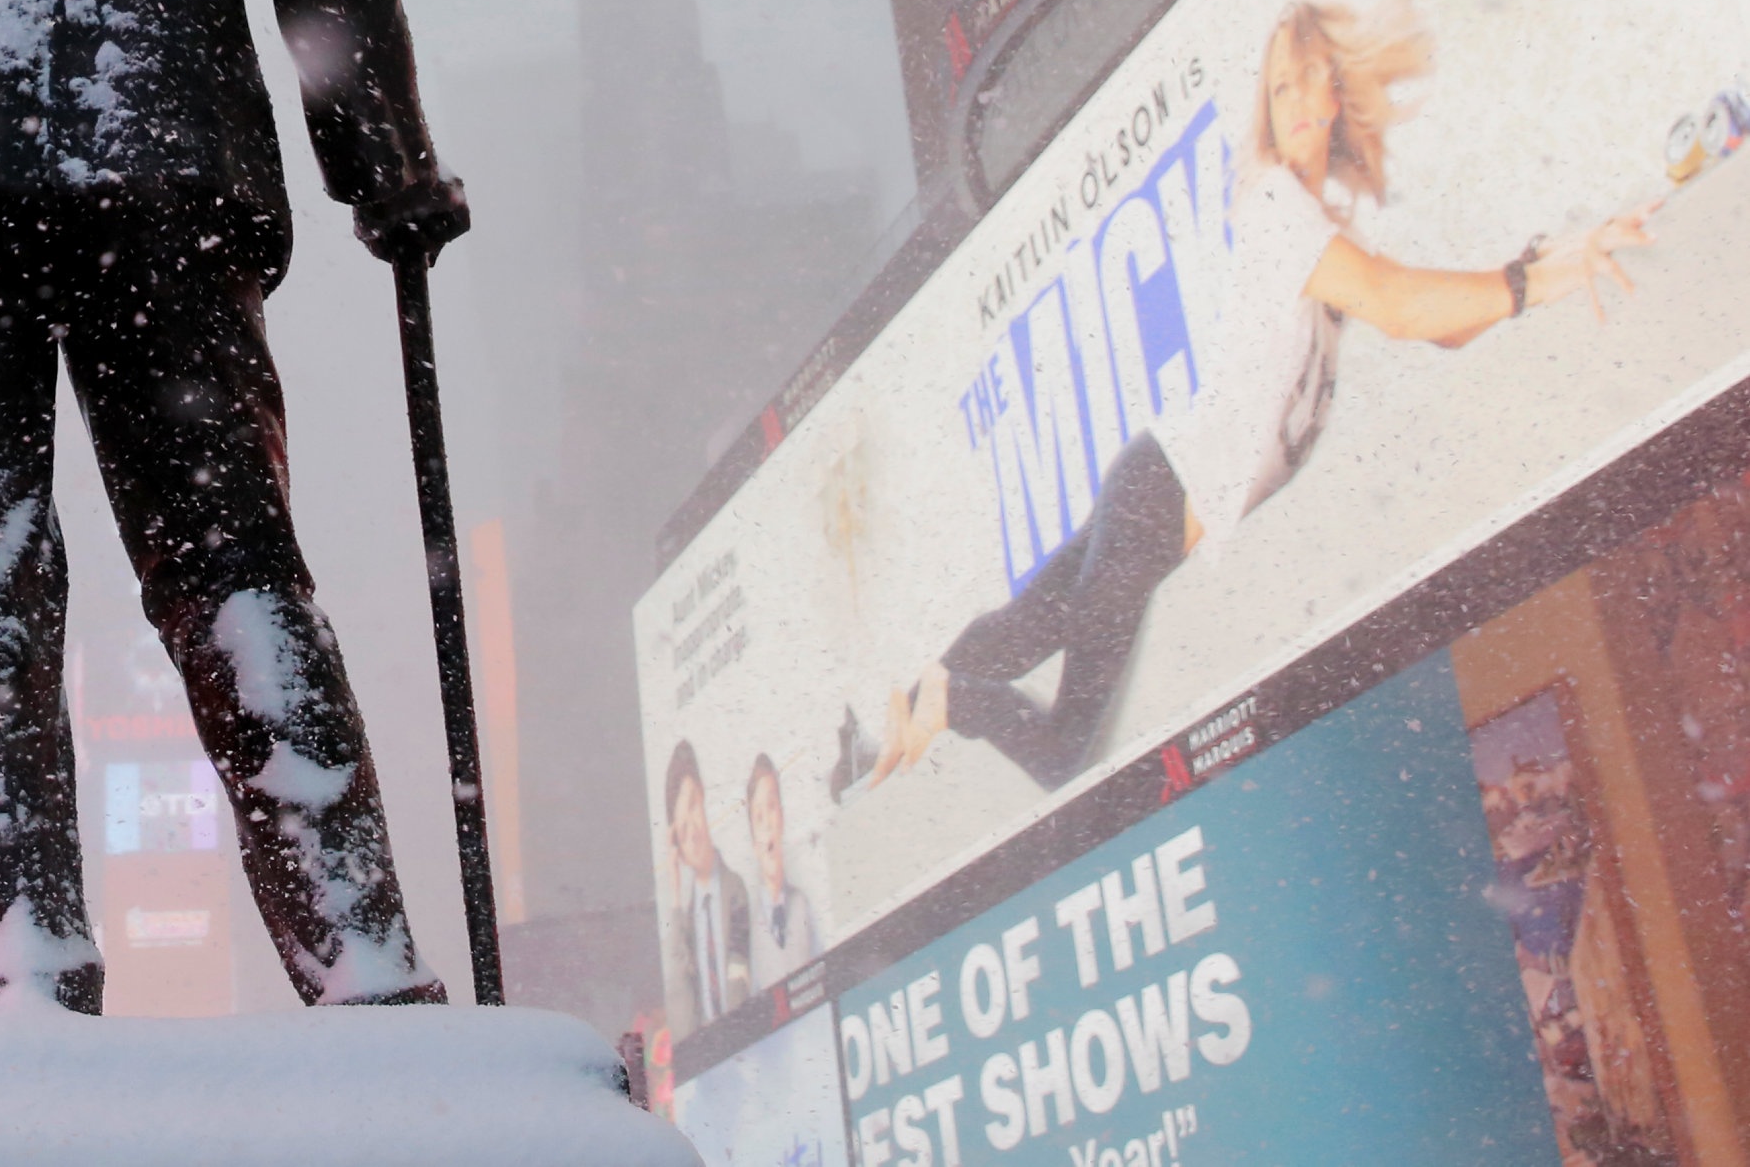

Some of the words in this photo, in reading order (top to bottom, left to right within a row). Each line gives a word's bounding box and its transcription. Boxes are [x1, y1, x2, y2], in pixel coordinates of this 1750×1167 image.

[979, 195, 1070, 330] KAITLIN
[1080, 82, 1169, 213] OLSON
[1181, 56, 1206, 101] IS
[957, 351, 1011, 453] THE
[840, 970, 949, 1101] ONE
[959, 917, 1041, 1039] OF
[1055, 825, 1218, 989] THE
[854, 1075, 964, 1167] EST
[980, 952, 1252, 1151] SHOWS
